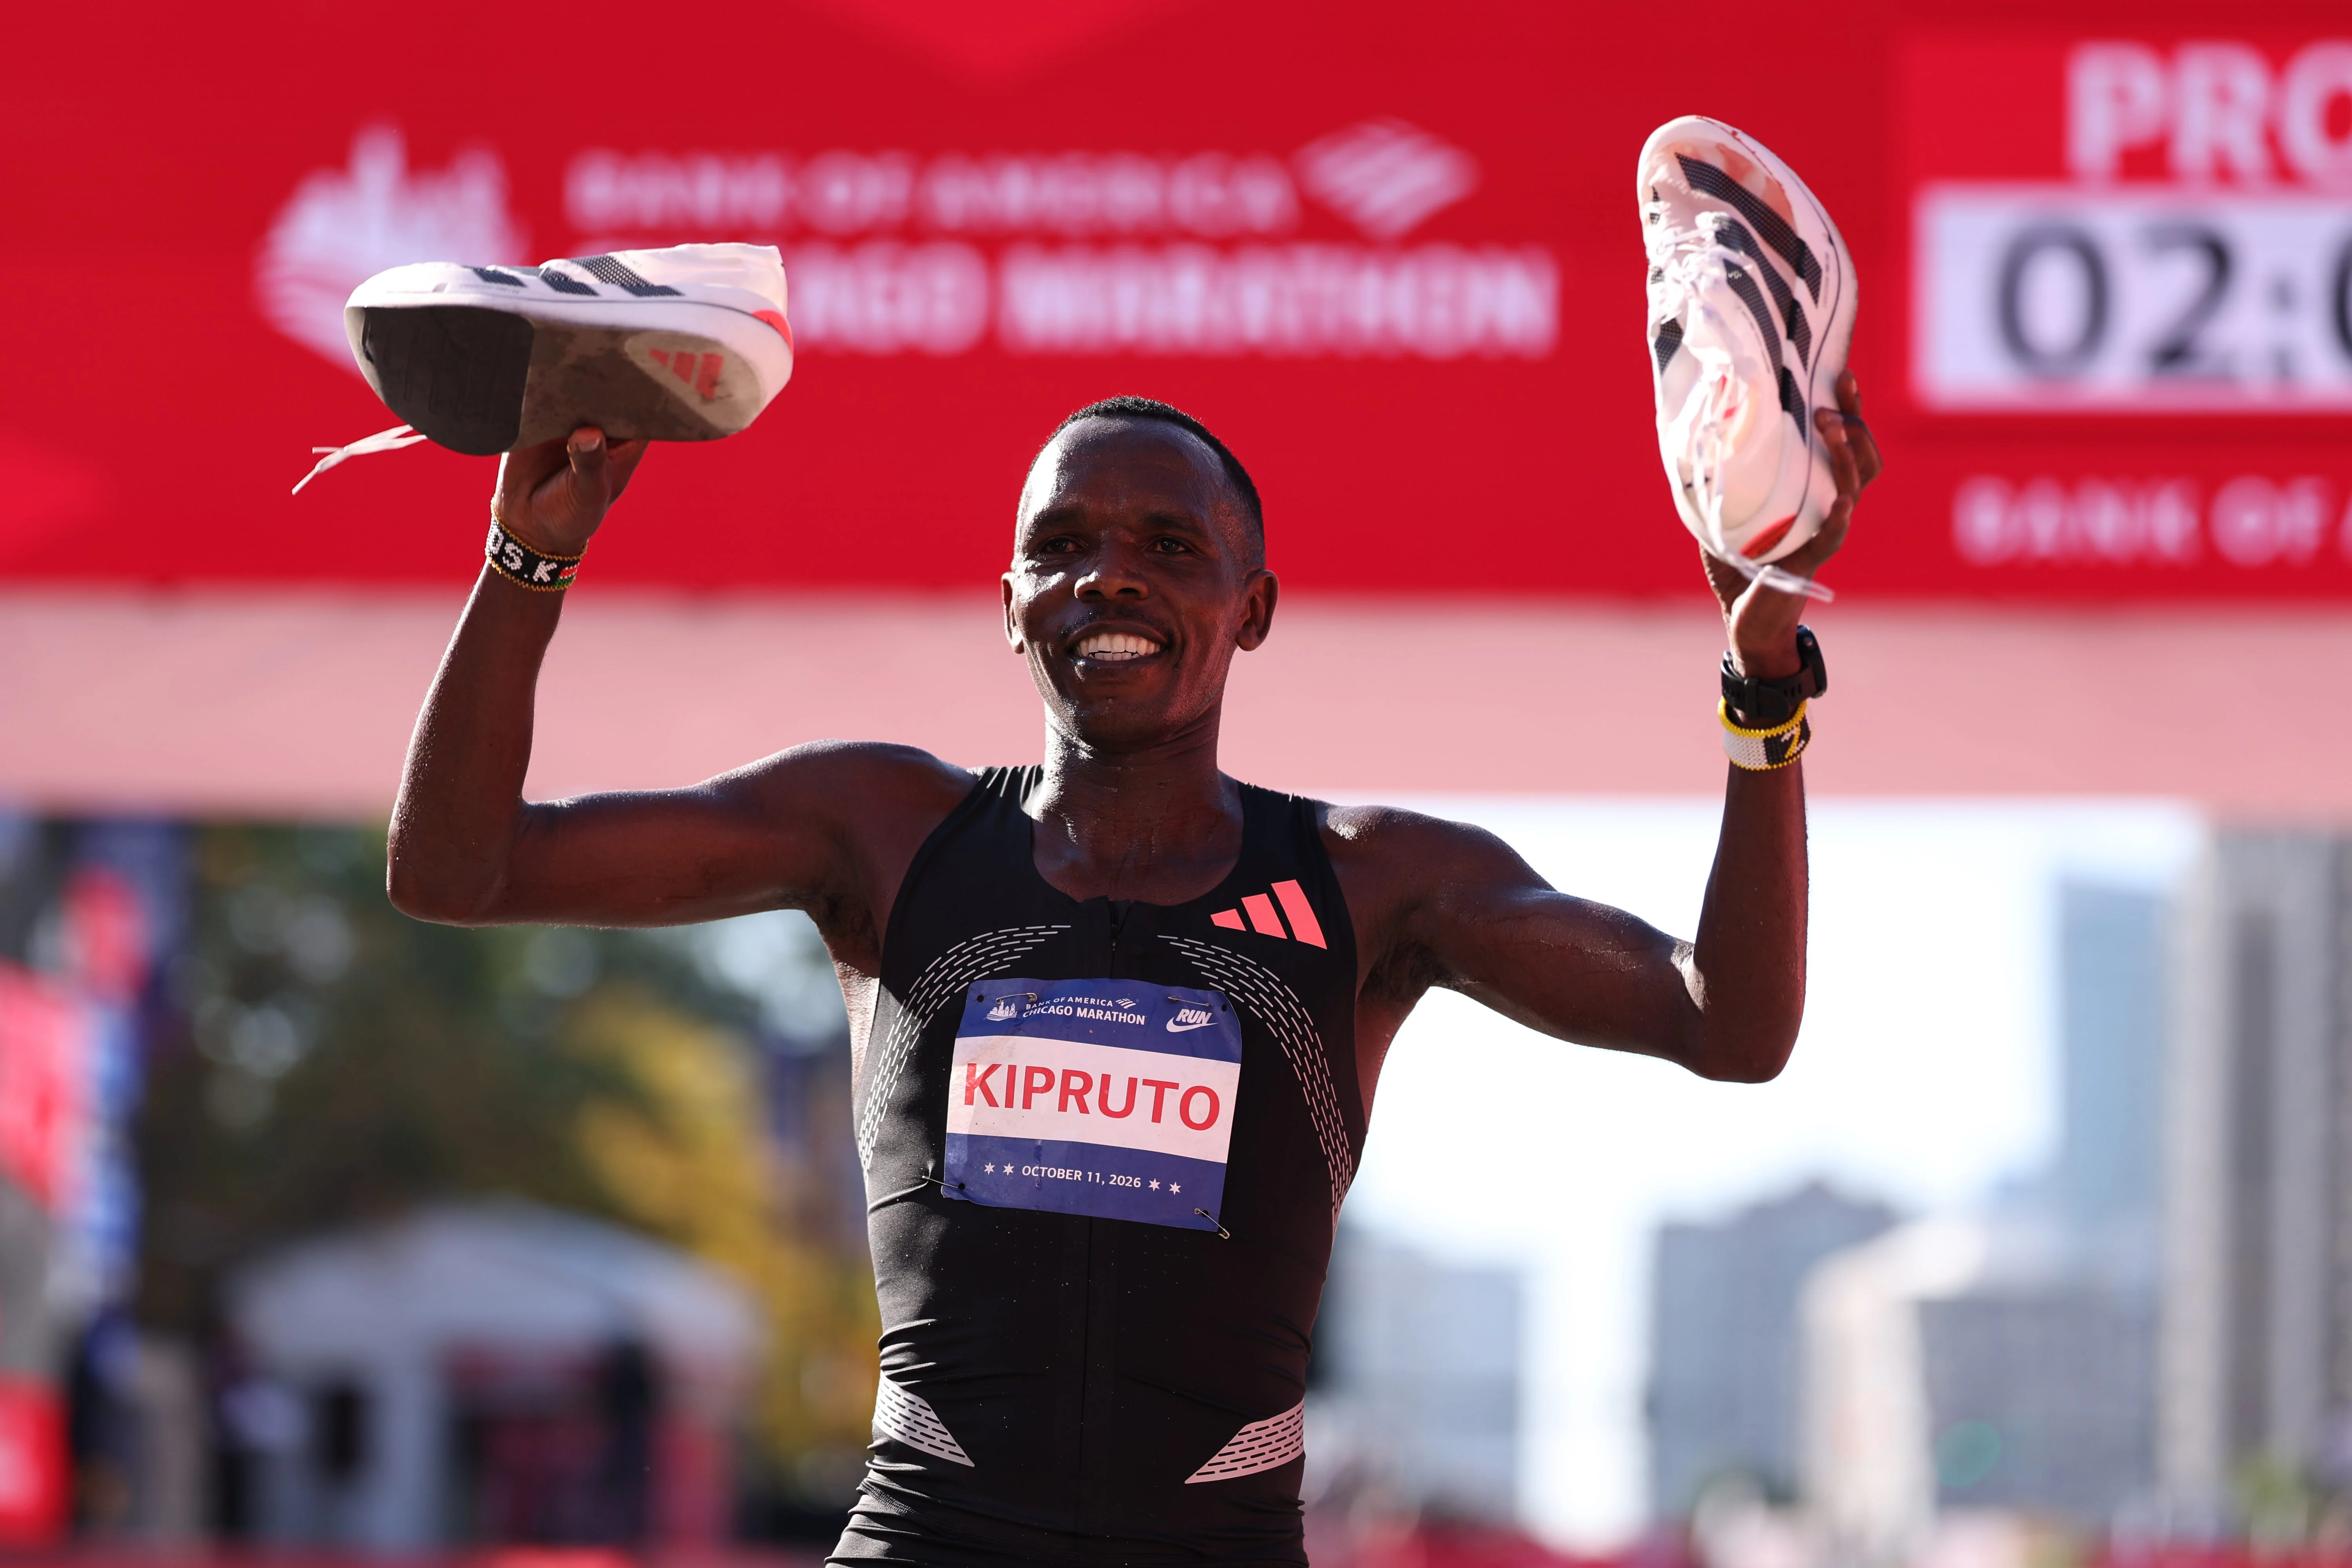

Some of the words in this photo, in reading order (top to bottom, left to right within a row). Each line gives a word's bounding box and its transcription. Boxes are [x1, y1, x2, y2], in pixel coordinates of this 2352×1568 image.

[2064, 38, 2352, 185] PRO
[999, 244, 1558, 356] MARATHON
[1026, 1000, 1051, 1010] BANK
[1067, 996, 1113, 1007] AMERICA
[1022, 1005, 1073, 1018] CHICAGO
[1076, 1007, 1145, 1025] MARATHON
[1175, 1008, 1212, 1024] RUN
[964, 1063, 1220, 1131] KIPRUTO
[1022, 1165, 1082, 1181] OCTOBER
[1087, 1171, 1105, 1185] 11,
[1109, 1174, 1142, 1188] 2026
